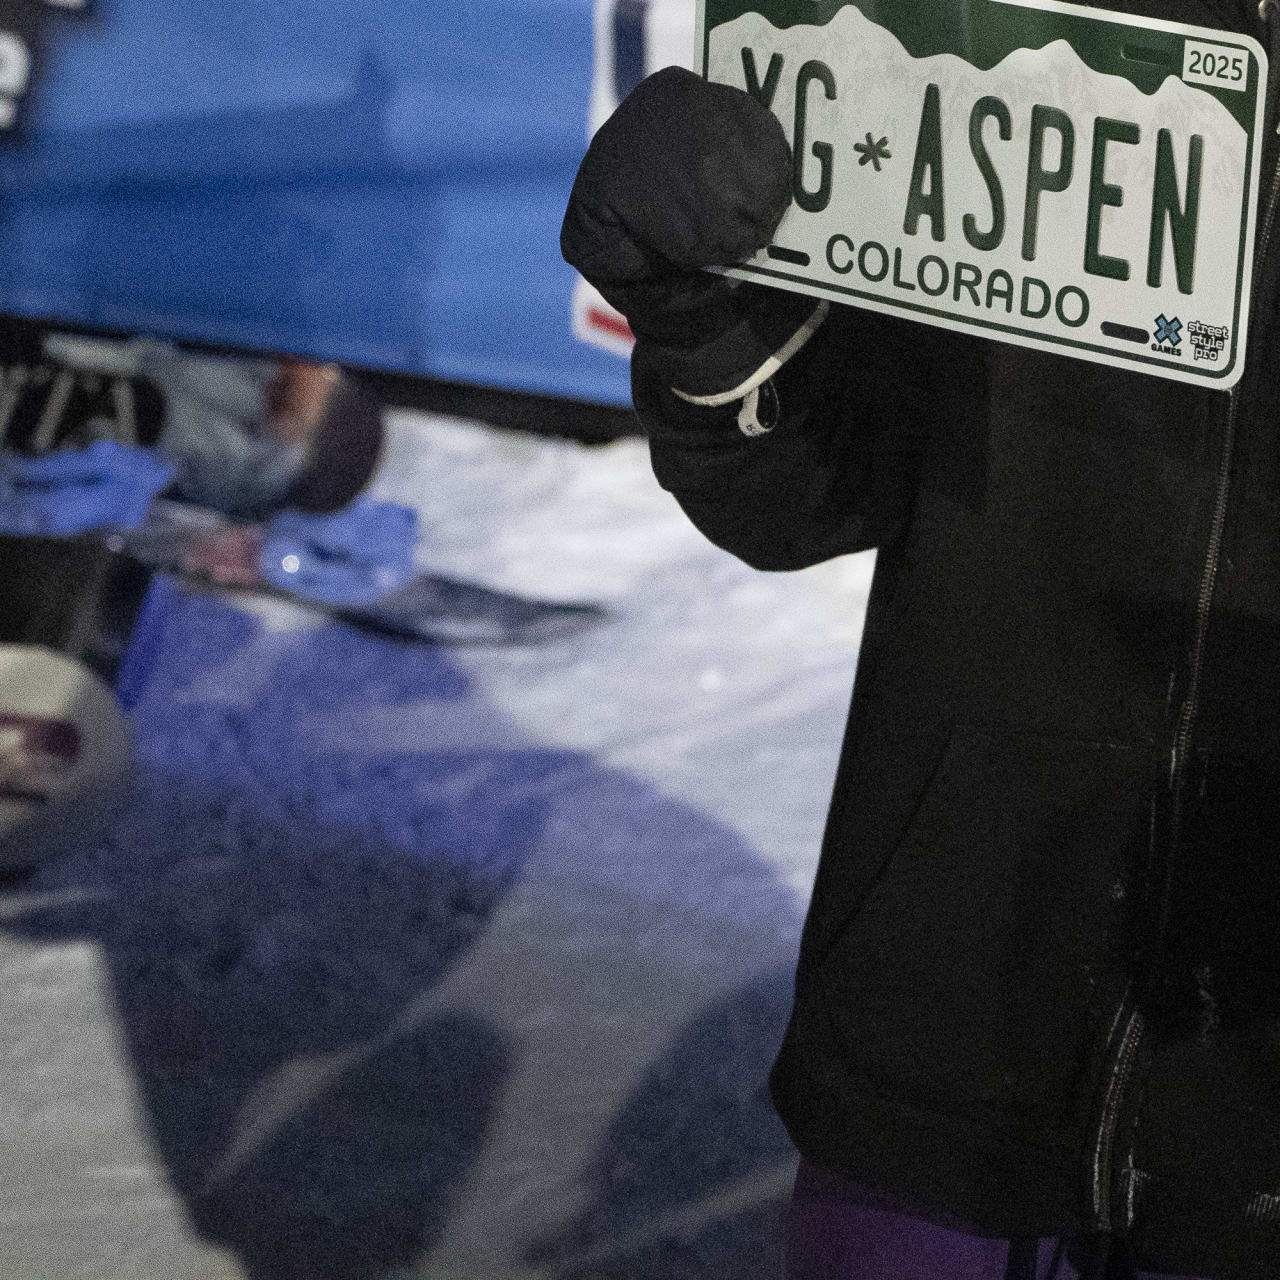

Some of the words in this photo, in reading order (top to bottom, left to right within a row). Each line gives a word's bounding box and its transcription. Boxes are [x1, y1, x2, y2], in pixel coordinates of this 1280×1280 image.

[1188, 50, 1243, 82] 2025
[826, 233, 1090, 328] COLORADO
[1187, 321, 1229, 339] street
[1151, 343, 1182, 356] GAMES
[1190, 333, 1225, 351] style
[1194, 347, 1219, 361] pro
